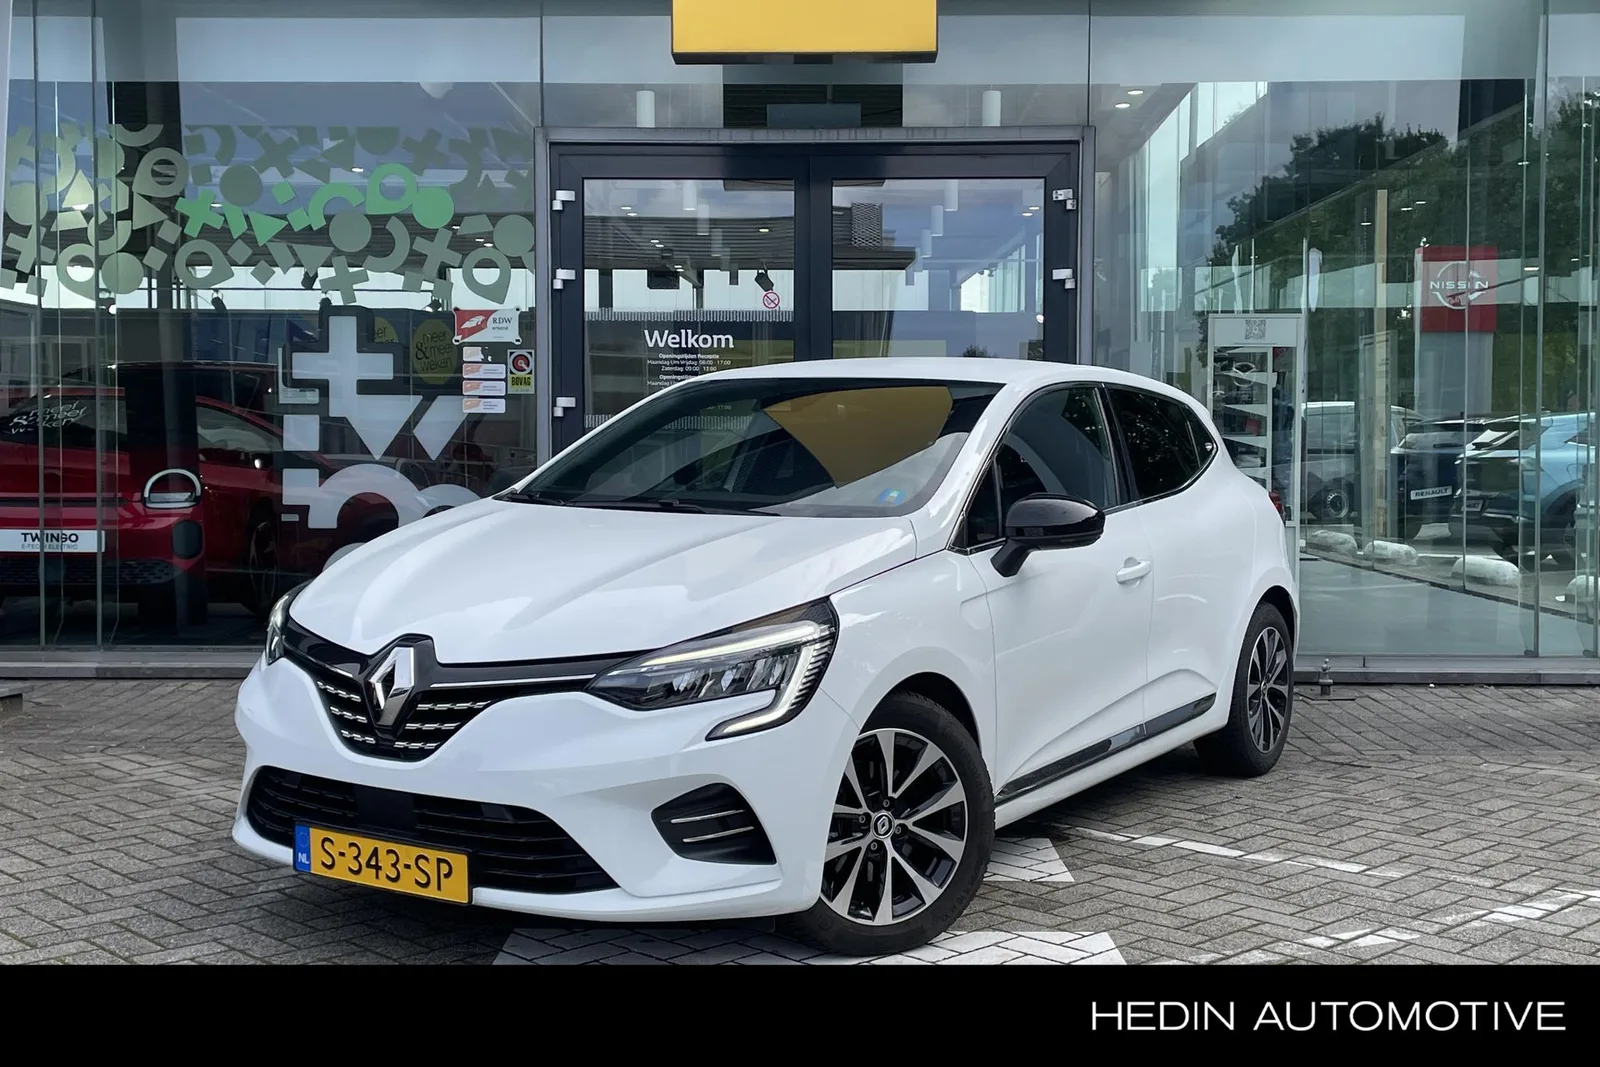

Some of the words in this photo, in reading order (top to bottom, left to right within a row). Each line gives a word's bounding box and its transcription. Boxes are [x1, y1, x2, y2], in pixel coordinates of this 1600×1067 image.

[644, 329, 735, 348] Welkom
[511, 376, 532, 386] BOVAG
[21, 532, 79, 543] TWINGO
[298, 852, 310, 864] NL
[320, 836, 453, 892] S-343-SP
